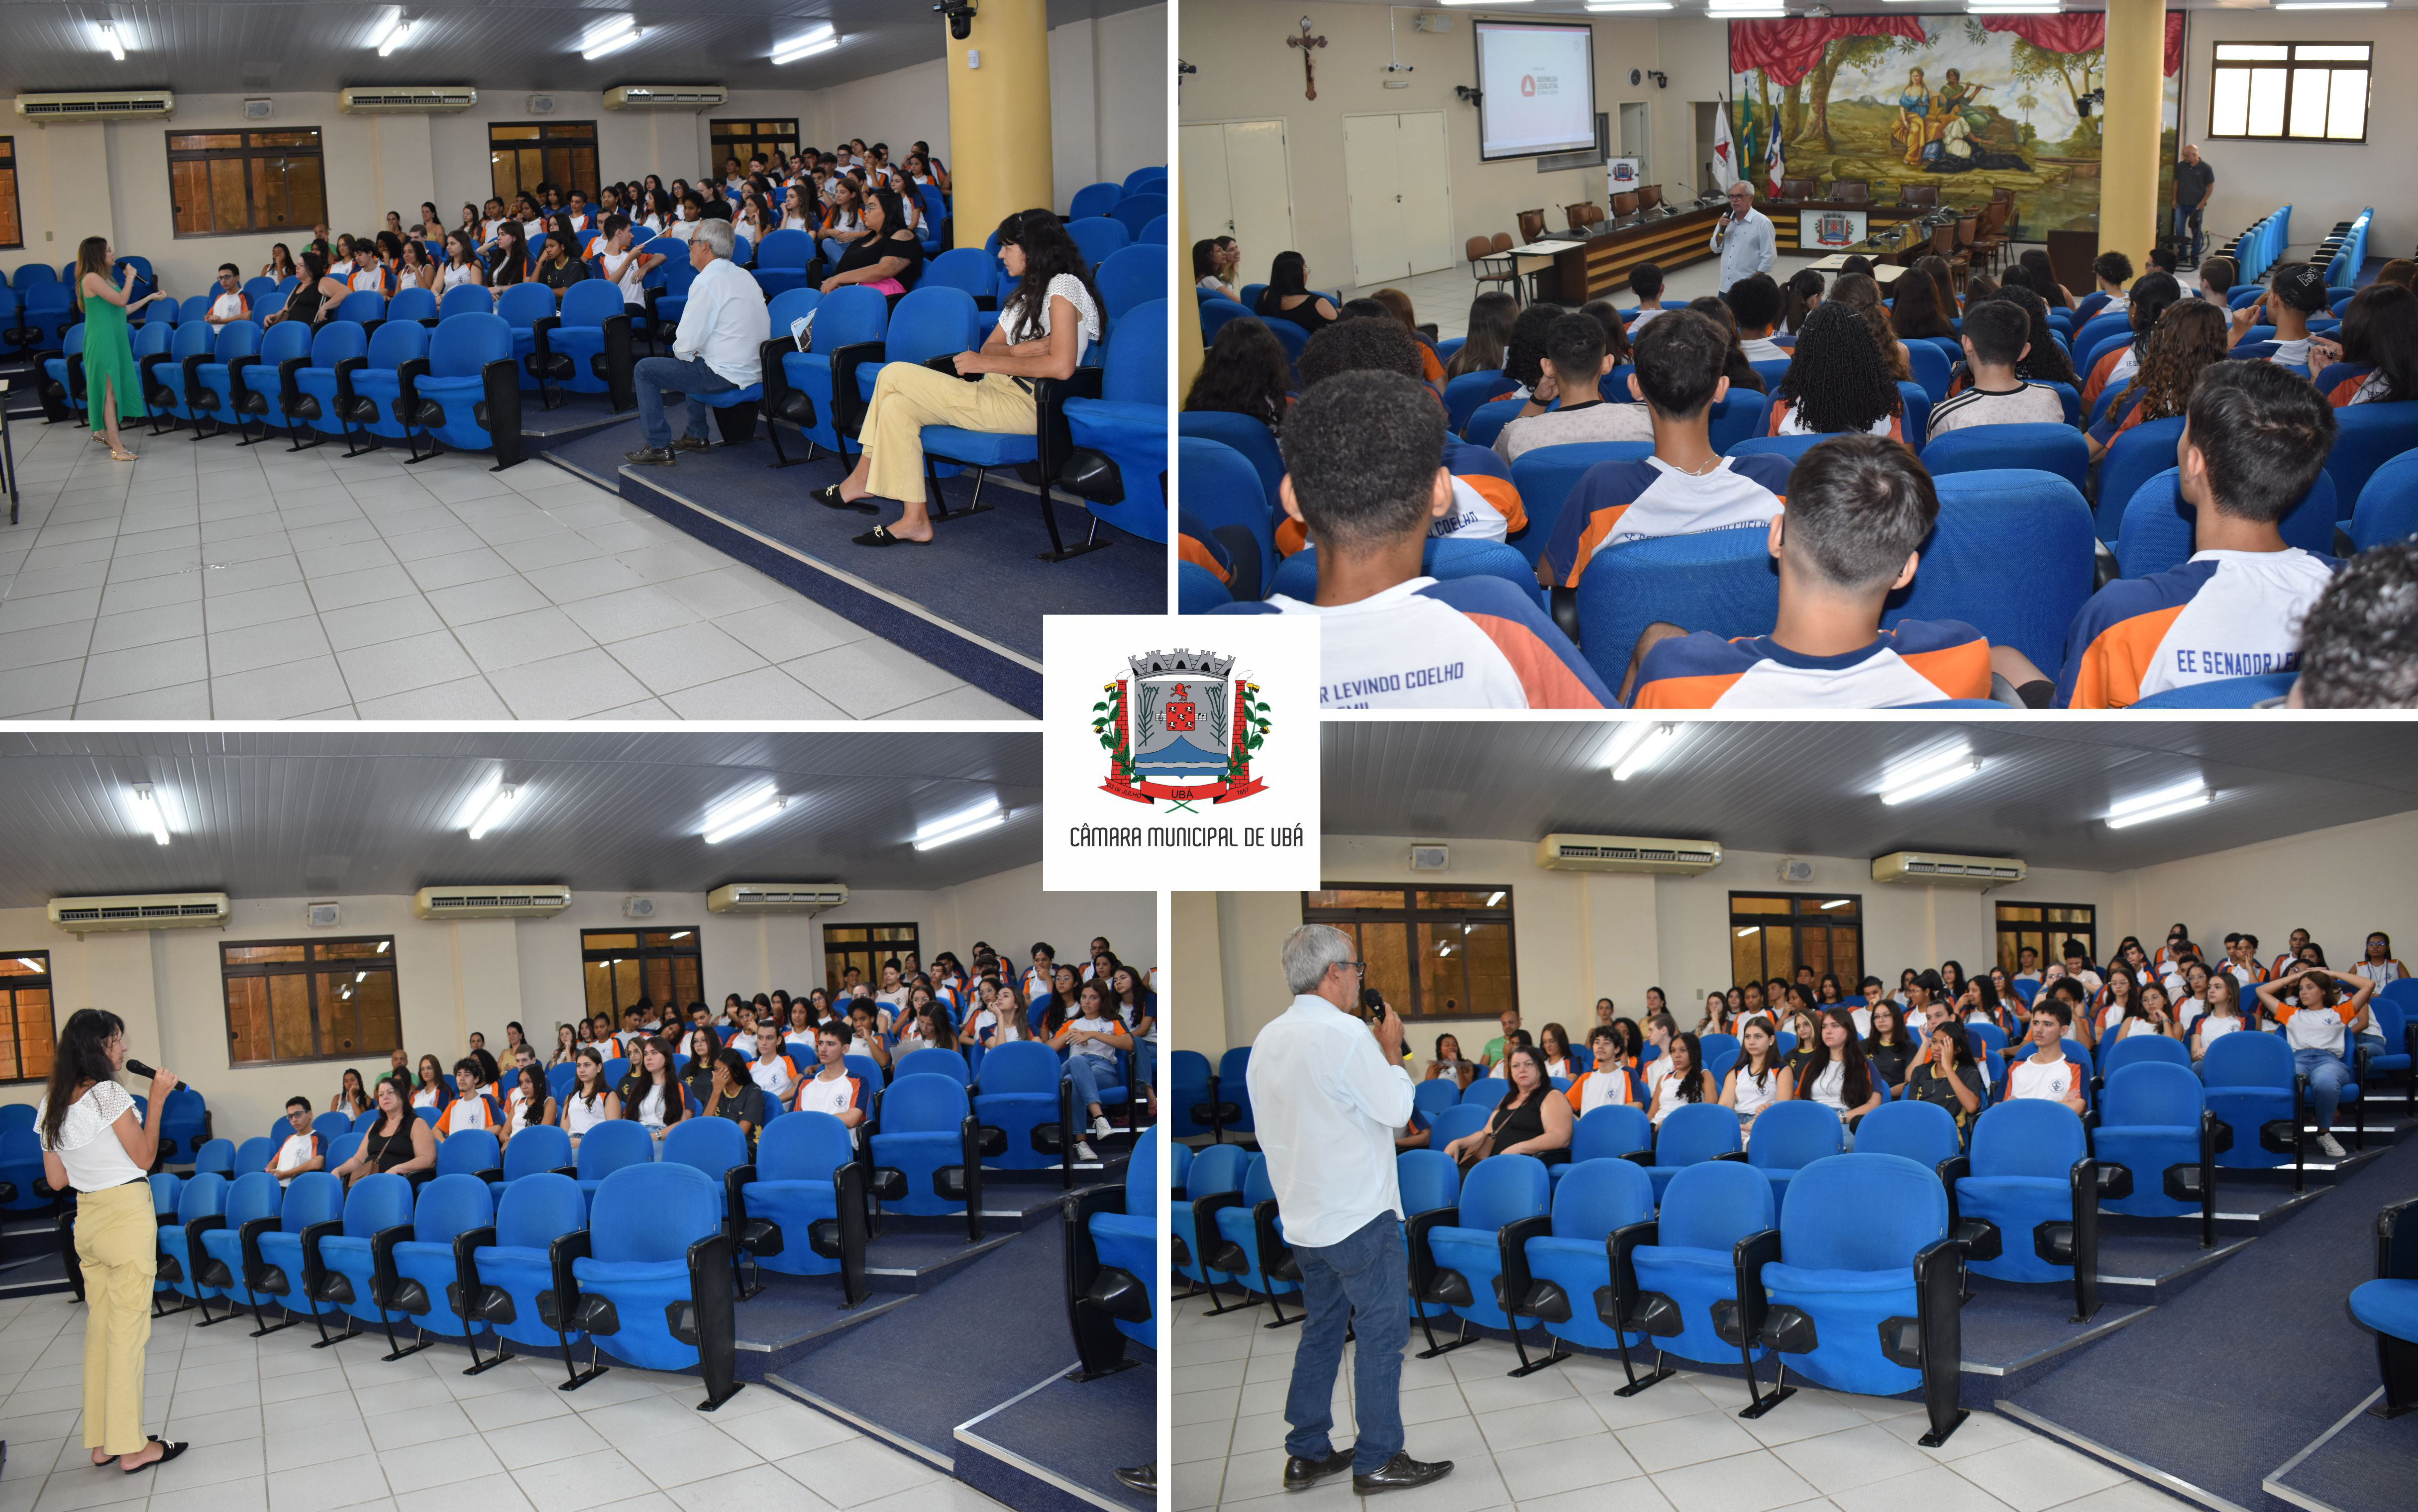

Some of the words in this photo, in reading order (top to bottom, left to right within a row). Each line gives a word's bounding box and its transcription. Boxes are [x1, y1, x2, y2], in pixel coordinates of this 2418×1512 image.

[1435, 511, 1478, 536] COELHO
[2177, 650, 2197, 672] EE
[2203, 651, 2271, 676] SENADOR
[1334, 674, 1400, 700] LEVINDO
[1406, 662, 1464, 689] COELHO
